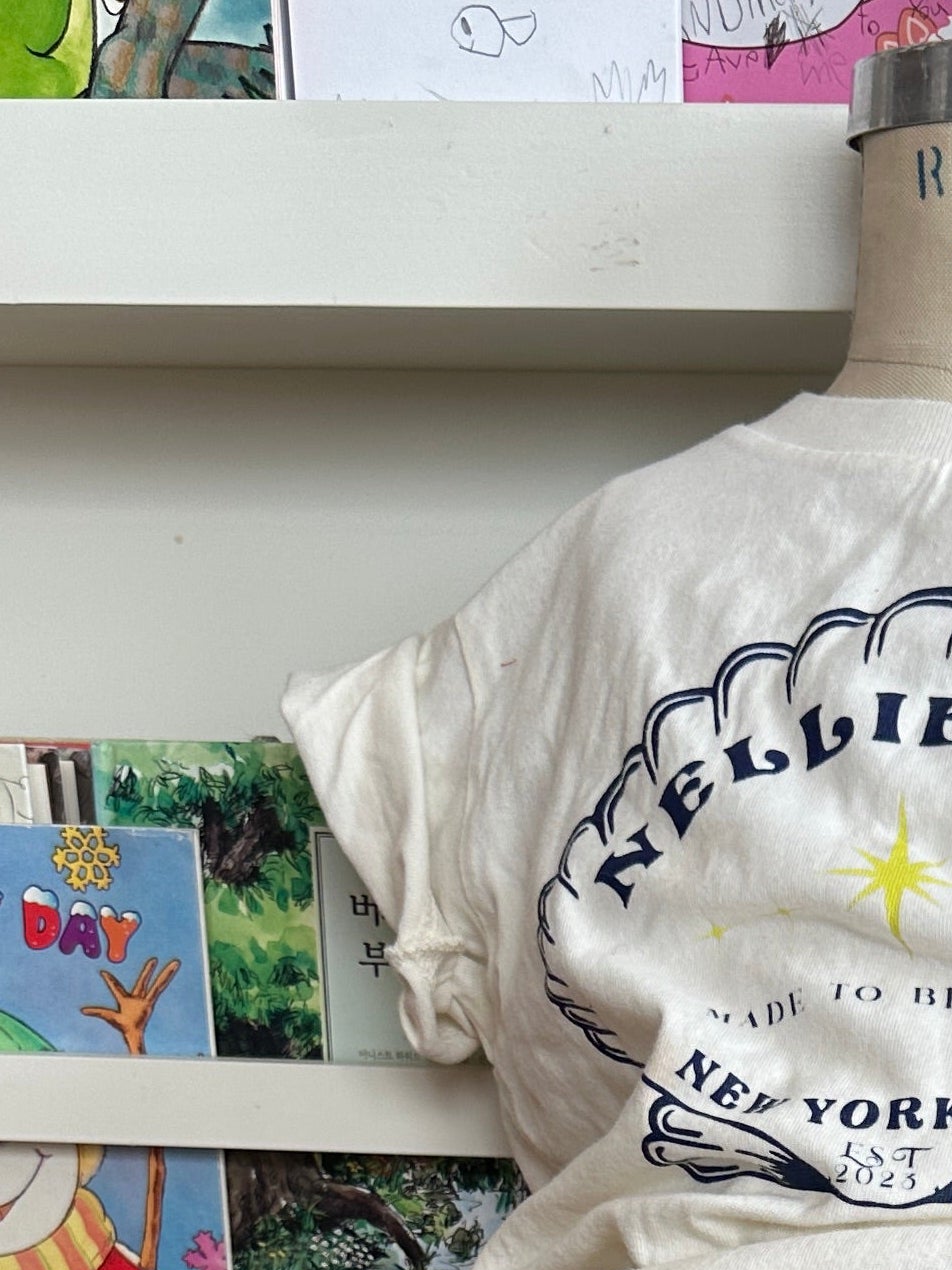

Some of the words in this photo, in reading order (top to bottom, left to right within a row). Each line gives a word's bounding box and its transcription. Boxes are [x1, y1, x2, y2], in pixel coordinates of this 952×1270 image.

[22, 884, 142, 963] DAY
[830, 982, 883, 1004] TO
[835, 1163, 917, 1190] 2023
